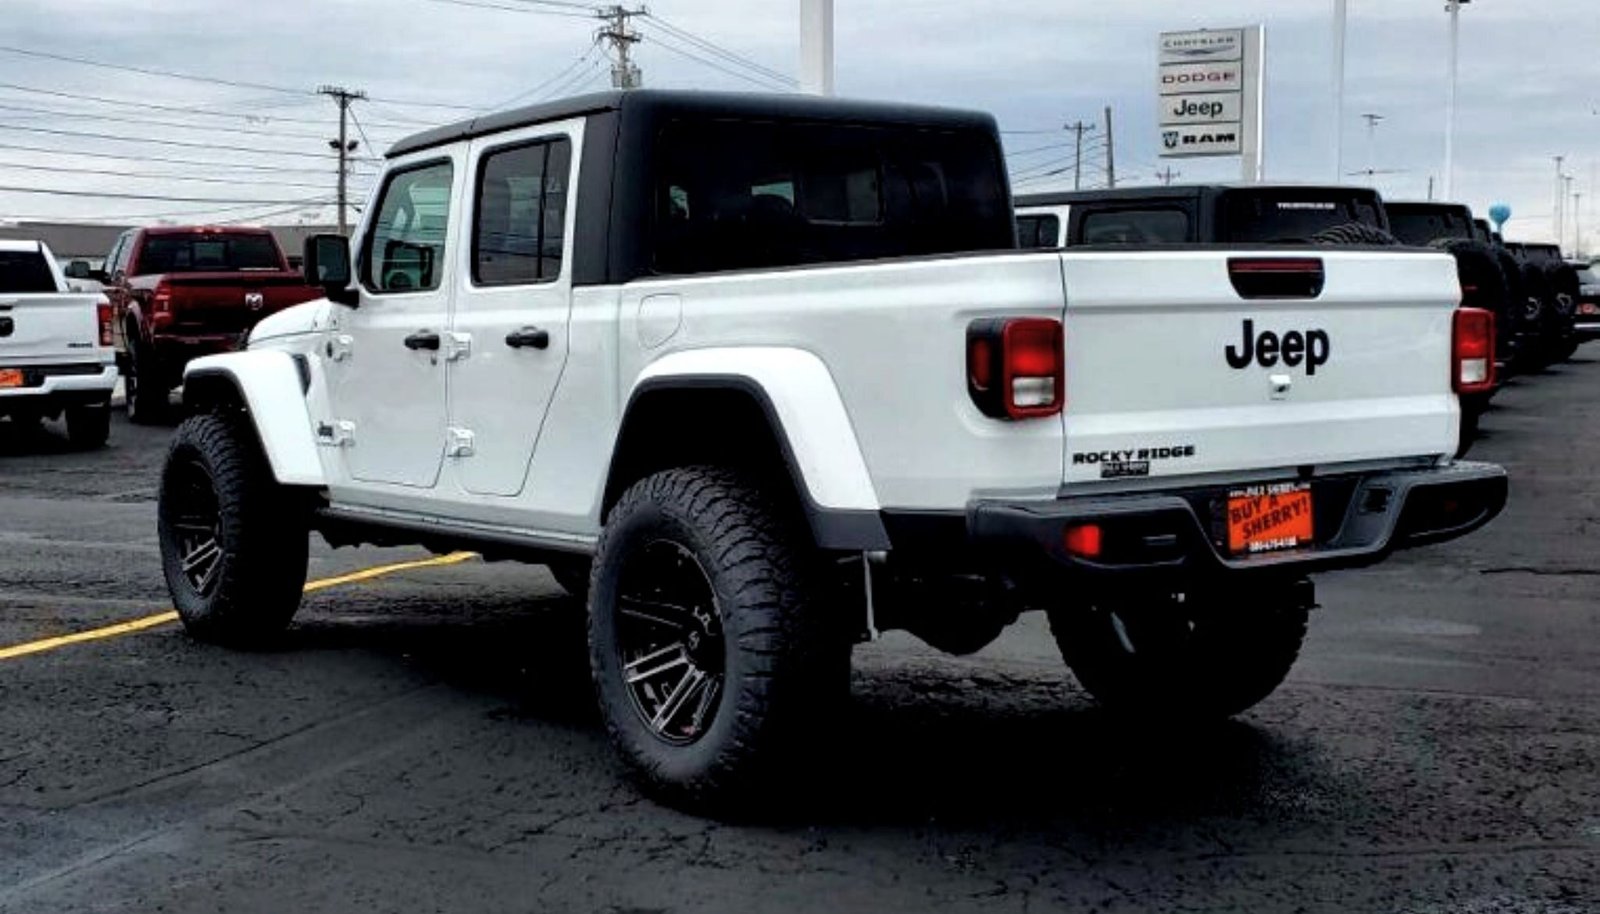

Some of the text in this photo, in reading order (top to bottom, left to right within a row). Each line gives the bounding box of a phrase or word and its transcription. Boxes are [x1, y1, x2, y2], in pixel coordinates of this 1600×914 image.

[1162, 72, 1235, 83] DODGE
[1173, 99, 1223, 117] Jeep
[1182, 133, 1235, 144] RAM
[1225, 319, 1330, 375] Jeep
[1072, 445, 1194, 464] ROCKY RIDGE
